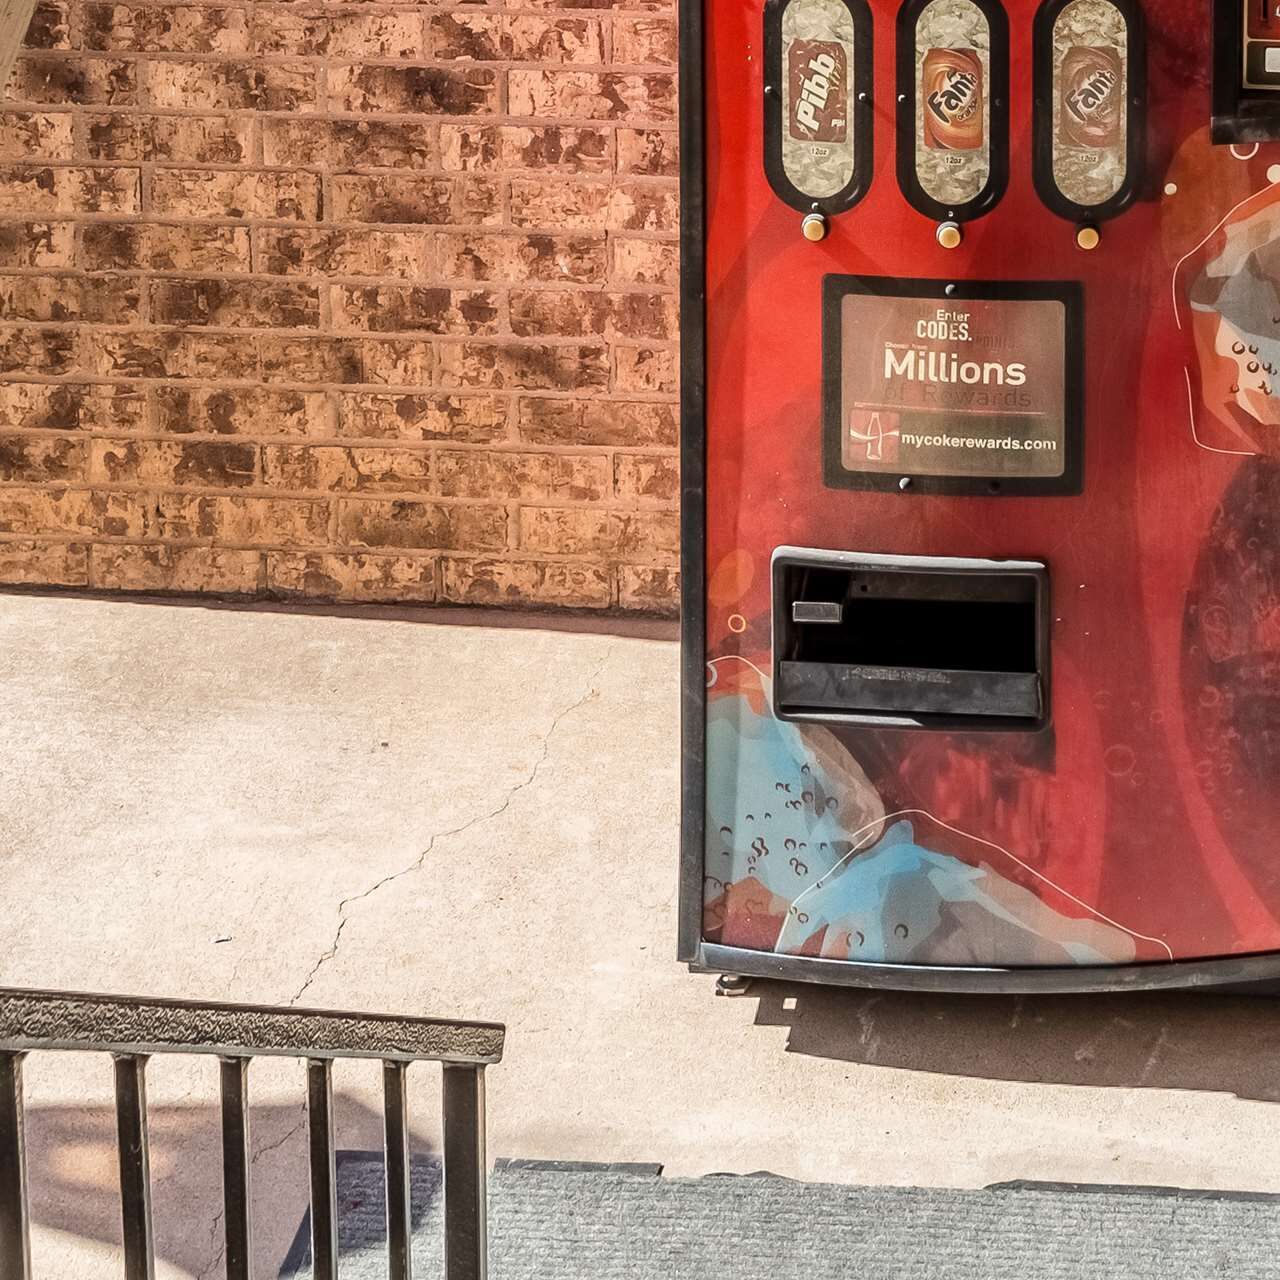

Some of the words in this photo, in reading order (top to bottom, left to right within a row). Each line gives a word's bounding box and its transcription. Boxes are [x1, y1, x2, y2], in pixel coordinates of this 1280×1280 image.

[927, 70, 978, 124] Fanta
[1065, 70, 1117, 123] Fanta
[936, 309, 970, 322] Enter
[917, 320, 972, 341] CODES.
[884, 348, 1027, 386] Millions
[923, 385, 1031, 407] Rewards
[901, 433, 1057, 451] mycokerewards.com
